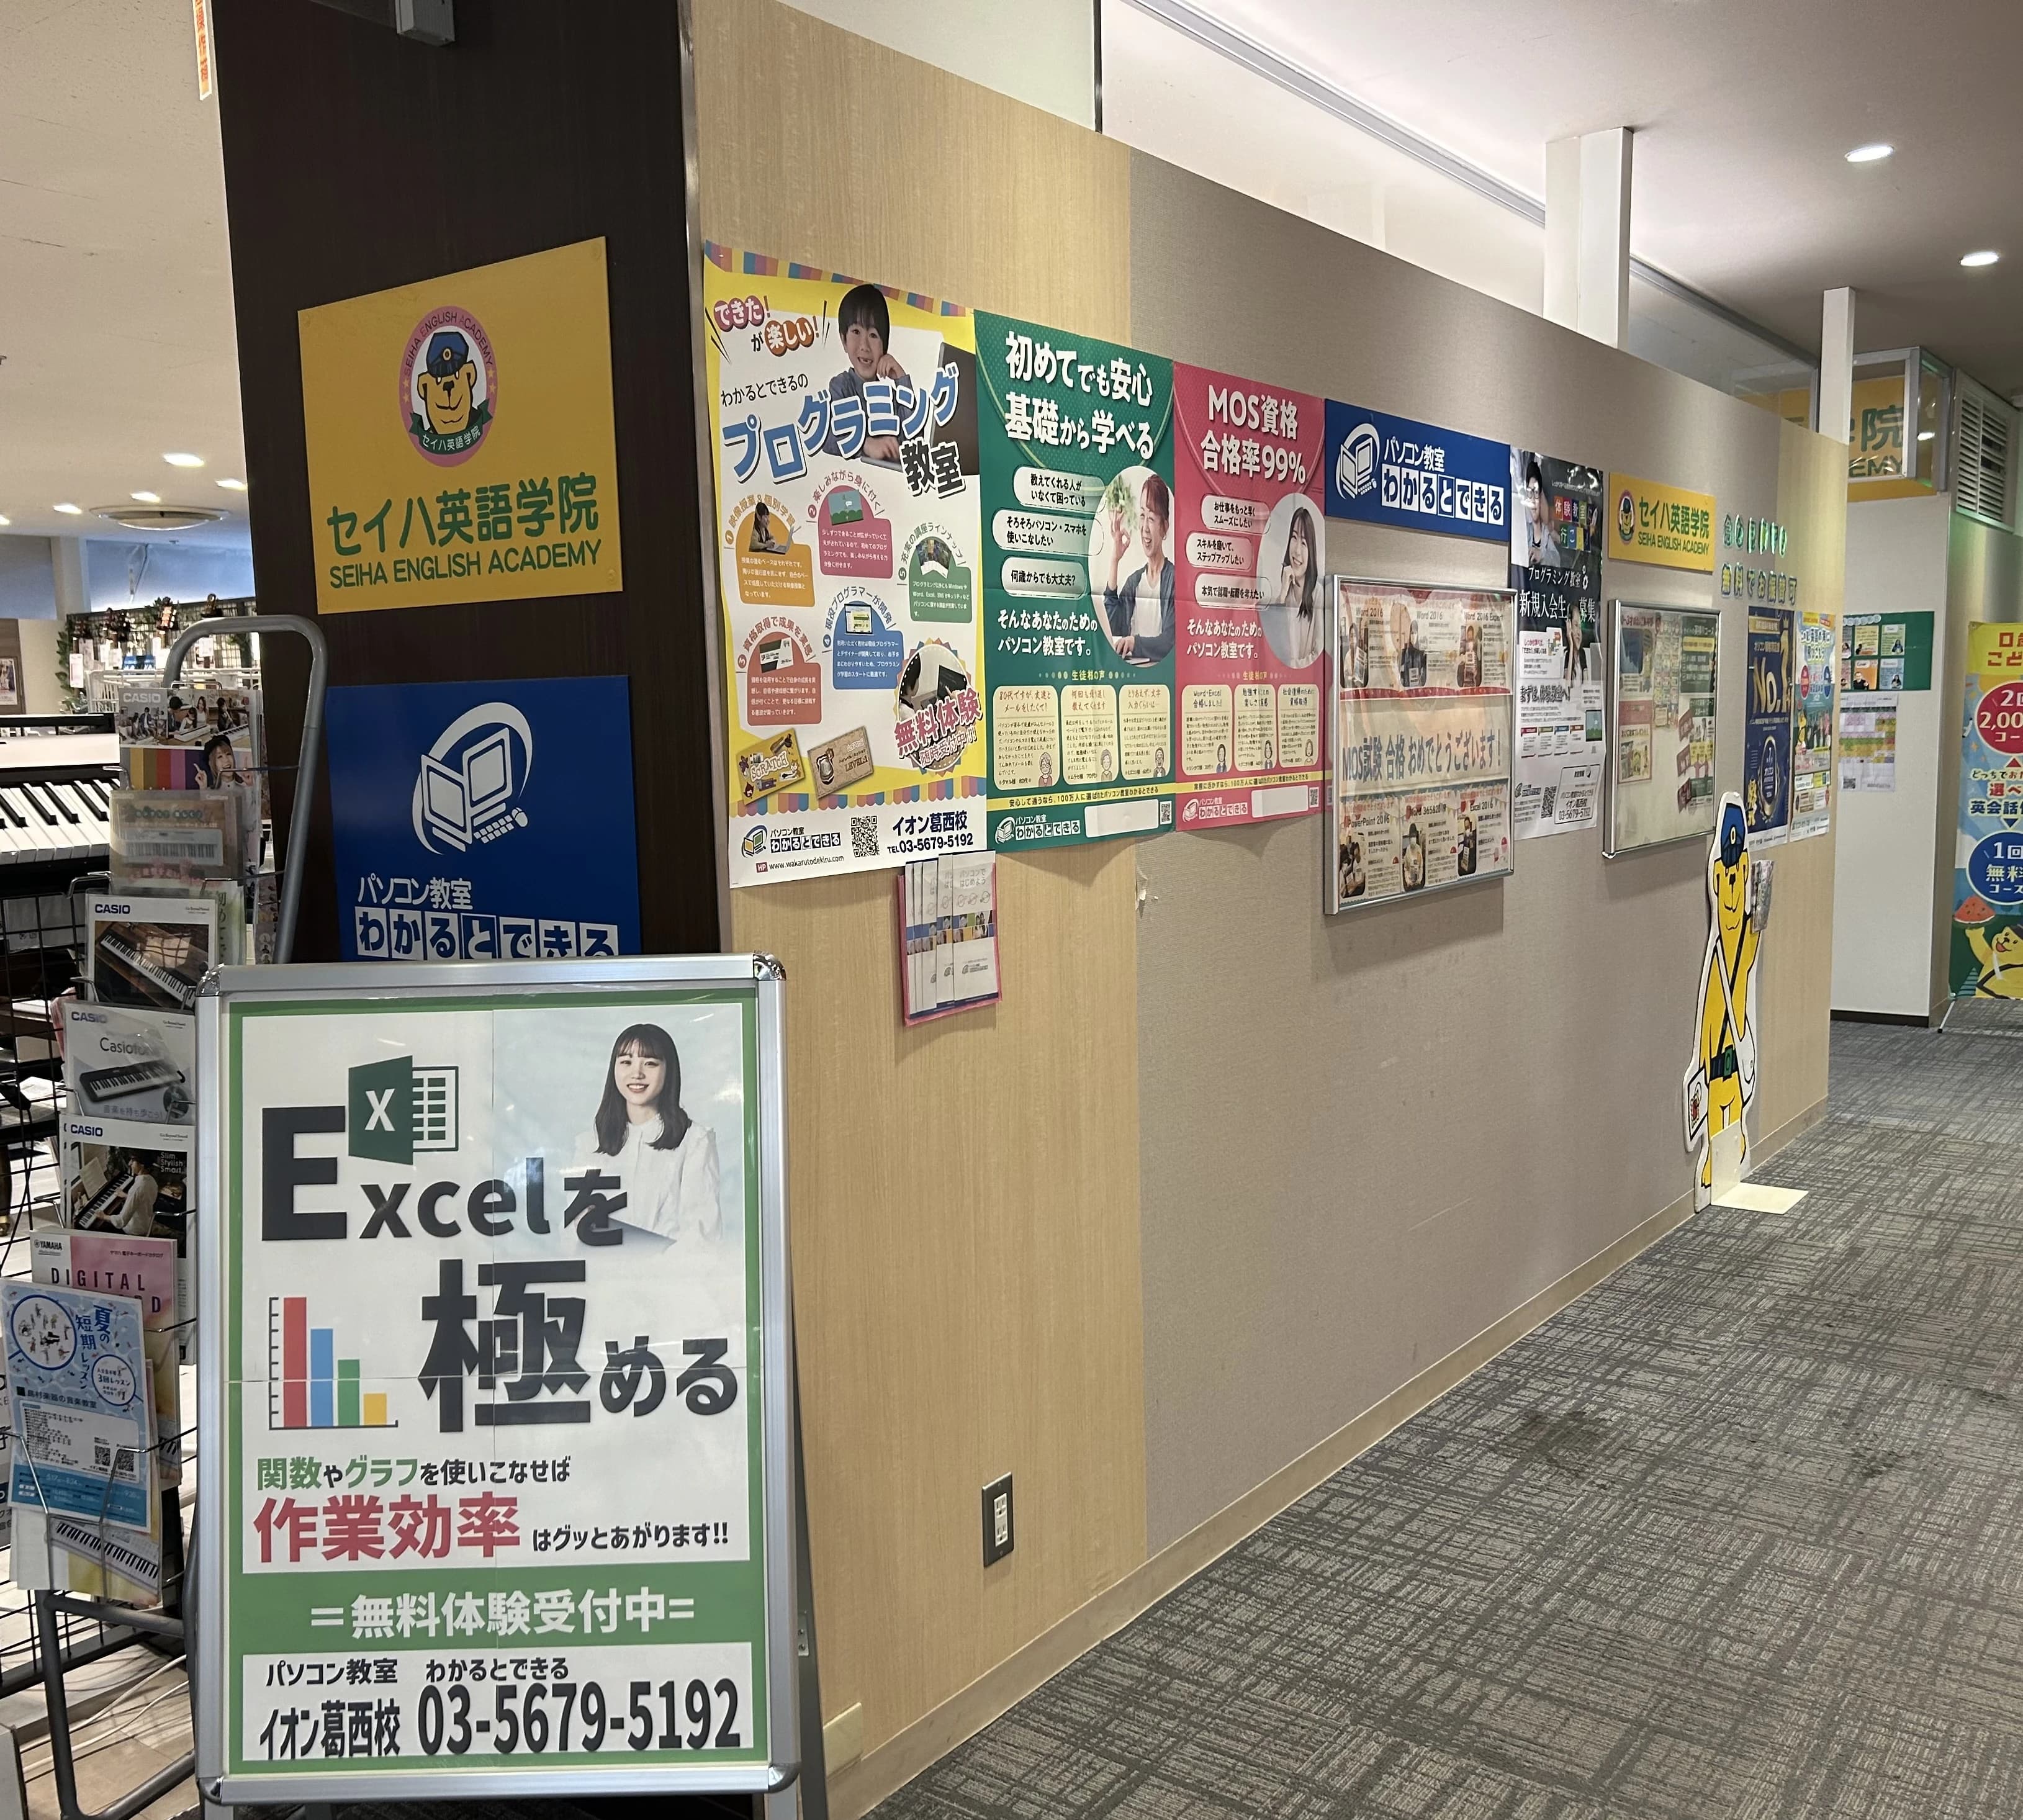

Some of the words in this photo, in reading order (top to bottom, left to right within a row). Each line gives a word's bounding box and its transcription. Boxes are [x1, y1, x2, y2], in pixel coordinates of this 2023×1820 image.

[404, 336, 421, 376] SEIHA
[420, 311, 457, 338] ENGLISH
[458, 314, 493, 367] ACADEMY
[1005, 331, 1153, 407] 初めてでも安心
[721, 373, 808, 407] わかるとできるの
[723, 365, 958, 481] プログラミング
[1209, 385, 1298, 439] MOS資格
[1005, 392, 1153, 459] 基礎から学べる
[422, 425, 481, 452] セイハ英語学院
[1201, 430, 1305, 484] 合格率99%
[1384, 436, 1445, 472] パソコン教室
[901, 441, 964, 495] 教室
[813, 469, 880, 510] 楽しみながら身に付く
[1030, 474, 1082, 492] 教えてくれる人が
[1031, 491, 1086, 507] いなくて困っている
[1381, 463, 1504, 526] わかるとできる
[327, 472, 599, 556] セイハ英語学院
[1214, 502, 1255, 516] お仕事をもっと早く
[1639, 497, 1710, 539] セイハ英語学院
[1007, 516, 1087, 536] そろそろパソコン・スマホを
[1214, 516, 1252, 528] スムーズにしたい
[901, 522, 963, 564] 充実の講座ラインナップ
[1007, 531, 1053, 546] 使いこなしたい
[1197, 539, 1234, 552] スキルを磨いて、
[1638, 534, 1656, 547] SEIHA
[1657, 536, 1681, 551] ENGLISH
[1682, 539, 1710, 556] ACADEMY
[330, 561, 388, 588] SEIHA
[394, 551, 480, 582] ENGLISH
[489, 539, 601, 574] ACADEMY
[1197, 552, 1244, 565] ステップアップしたい
[1529, 567, 1581, 588] プログラミング教室
[1201, 585, 1264, 600] 本気で就職・転職を考えたい
[826, 586, 893, 630] 現役プログラマーが開発
[1356, 607, 1369, 617] Word
[1370, 608, 1384, 617] 2016
[1416, 611, 1428, 619] Word
[1430, 611, 1443, 619] 2016
[1464, 612, 1476, 621] Word
[1477, 612, 1489, 621] 2016
[998, 609, 1098, 632] そんなあなたのための
[1187, 619, 1262, 637] そんなあなたのための
[743, 616, 813, 657] 資格取得で成果を実感
[998, 636, 1091, 657] パソコン教室です。
[1187, 642, 1258, 659] パソコン教室です。
[1072, 670, 1106, 681] 生徒様の声
[123, 693, 161, 703] CASIO
[894, 690, 983, 758] 無料体験
[1199, 797, 1223, 805] パソコン教室
[1199, 803, 1248, 819] わかるとできる
[893, 811, 967, 836] イオン葛西校
[1016, 814, 1046, 824] パソコン教室
[1016, 820, 1080, 840] わかるとできる
[1377, 814, 1390, 825] 2016
[770, 826, 804, 836] パソコン教室
[770, 832, 840, 854] わかるとできる
[888, 845, 899, 854] TEL
[899, 833, 973, 854] 03-5679-5192
[756, 862, 768, 872] HP
[769, 855, 844, 870] www.wakarutodekiru.com
[960, 869, 986, 878] パソコンで
[358, 872, 473, 910] パソコン教室
[960, 877, 986, 887] はじめよう
[94, 904, 130, 914] CASIO
[354, 906, 619, 960] わかるとできる
[71, 1011, 107, 1024] CASIO
[364, 1088, 395, 1132] X
[71, 1124, 103, 1137] CASIO
[262, 1106, 628, 1246] Excelを
[40, 1241, 63, 1251] YAMAHA
[51, 1268, 145, 1291] DIGITAL
[94, 1305, 113, 1344] 夏の
[75, 1314, 97, 1390] 短期レッスン
[418, 1258, 739, 1432] 極める
[257, 1456, 572, 1490] 関数やグラフを使いこなせば
[253, 1491, 520, 1563] 作業効率
[266, 1658, 398, 1687] パソコン教室
[426, 1657, 569, 1682] わかるとできる
[259, 1699, 400, 1760] イオン葛西校
[418, 1678, 741, 1755] 03-5679-5192
